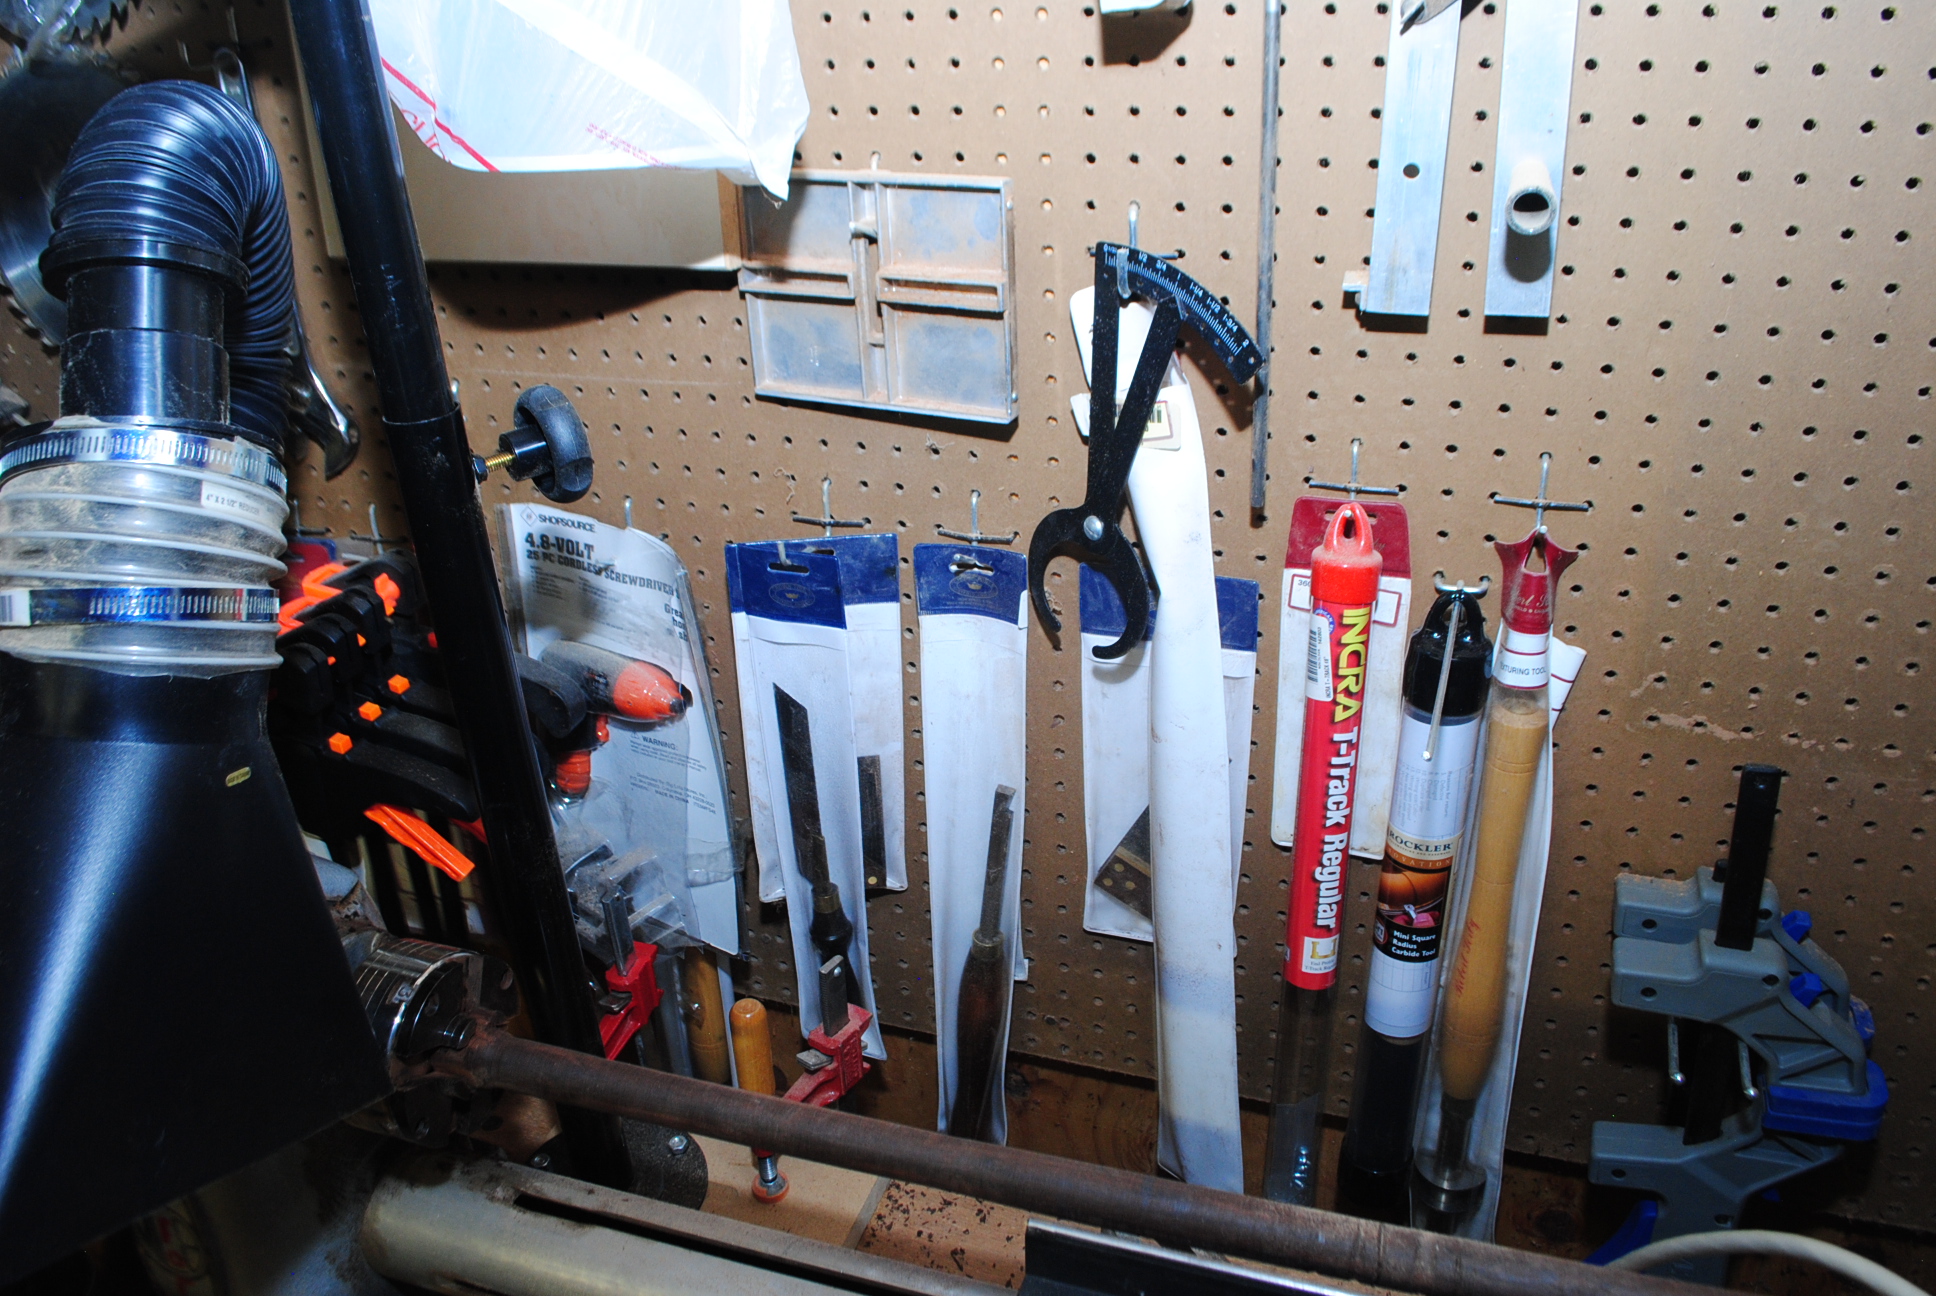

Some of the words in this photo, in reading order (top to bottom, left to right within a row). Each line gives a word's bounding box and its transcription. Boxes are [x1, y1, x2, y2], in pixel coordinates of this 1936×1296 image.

[1138, 251, 1148, 263] 1/2
[1155, 260, 1167, 272] 3/4
[1189, 282, 1203, 298] 1-1/4
[1206, 296, 1221, 314] 1-1/2
[1222, 313, 1238, 333] 1-3/4
[1242, 339, 1250, 348] 2
[525, 532, 594, 560] 4.8-VOLT
[526, 549, 539, 561] 25
[542, 552, 555, 564] PC
[1334, 606, 1371, 723] INCRA
[1531, 666, 1547, 675] TOOL
[641, 735, 678, 751] WARNING:
[1325, 726, 1358, 828] T-Track
[1388, 829, 1452, 853] ROCKLER
[1315, 831, 1349, 929] Regular
[1392, 938, 1417, 949] Radius
[1393, 930, 1410, 940] Mini
[1411, 934, 1437, 942] Square
[1391, 946, 1420, 957] Carbide
[1422, 948, 1436, 957] Tool
